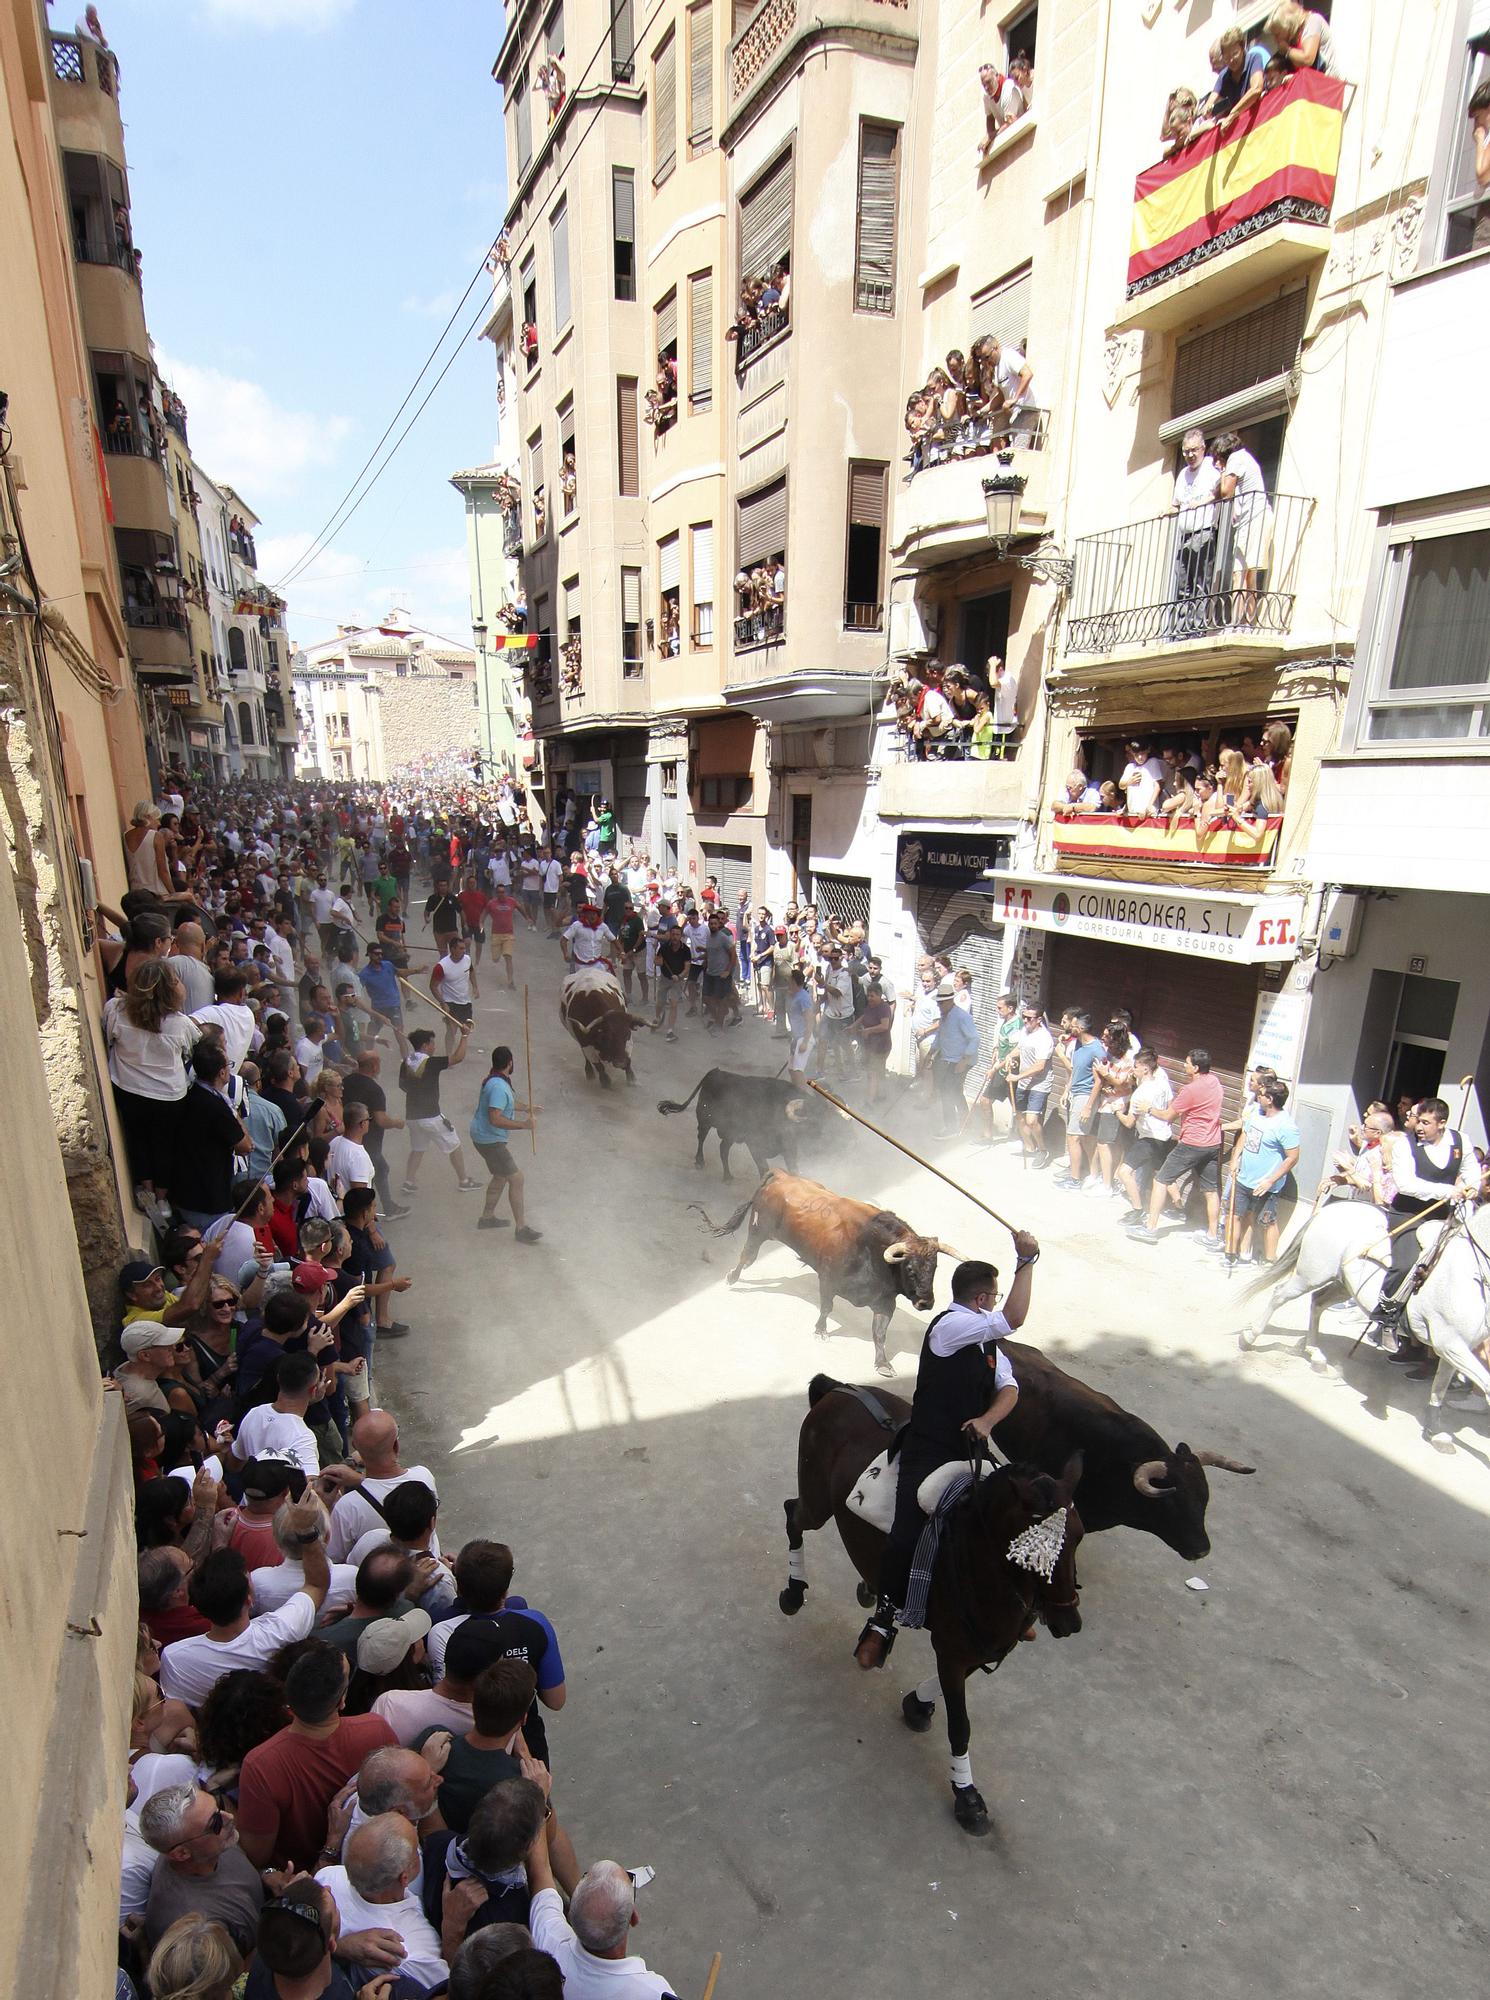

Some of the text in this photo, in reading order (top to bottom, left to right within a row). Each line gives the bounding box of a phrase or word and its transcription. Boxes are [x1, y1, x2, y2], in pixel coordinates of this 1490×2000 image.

[964, 855, 989, 869] VICENTE
[1003, 887, 1037, 922] F.T.
[1153, 932, 1166, 944] DE
[1176, 936, 1234, 955] SEGUROS
[1256, 918, 1296, 946] F.T.
[506, 1647, 528, 1657] DELS
